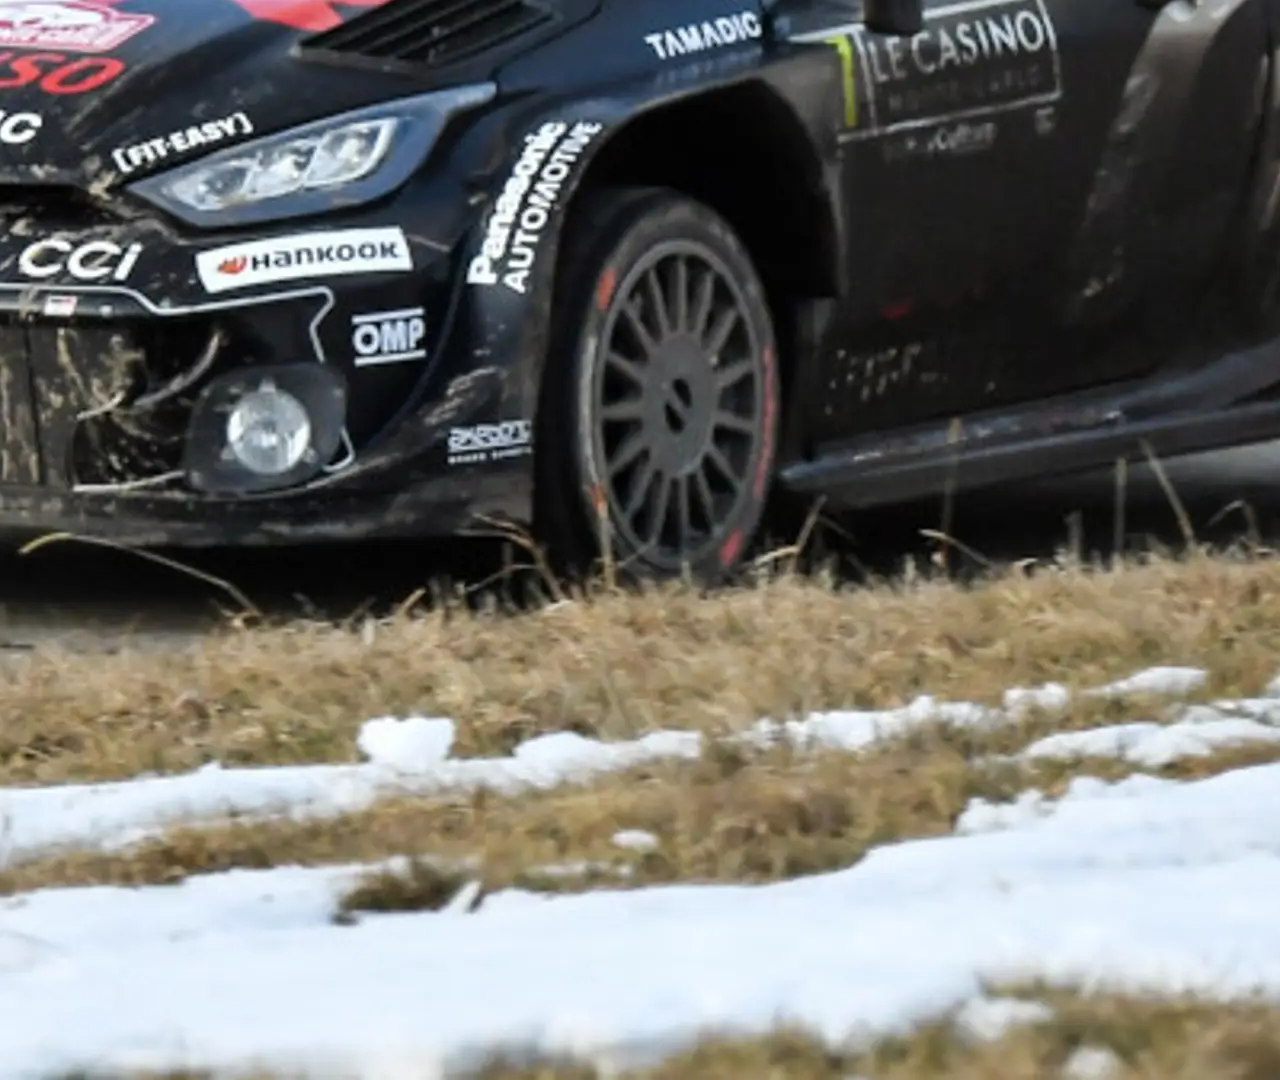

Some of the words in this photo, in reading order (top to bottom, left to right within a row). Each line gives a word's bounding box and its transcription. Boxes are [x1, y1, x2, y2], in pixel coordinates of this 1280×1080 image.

[644, 10, 763, 60] TAMADIC
[910, 9, 1044, 75] CASINO
[466, 120, 567, 286] Panasonic
[503, 120, 603, 294] AUTOMOTIVE
[352, 317, 426, 355] OMP
